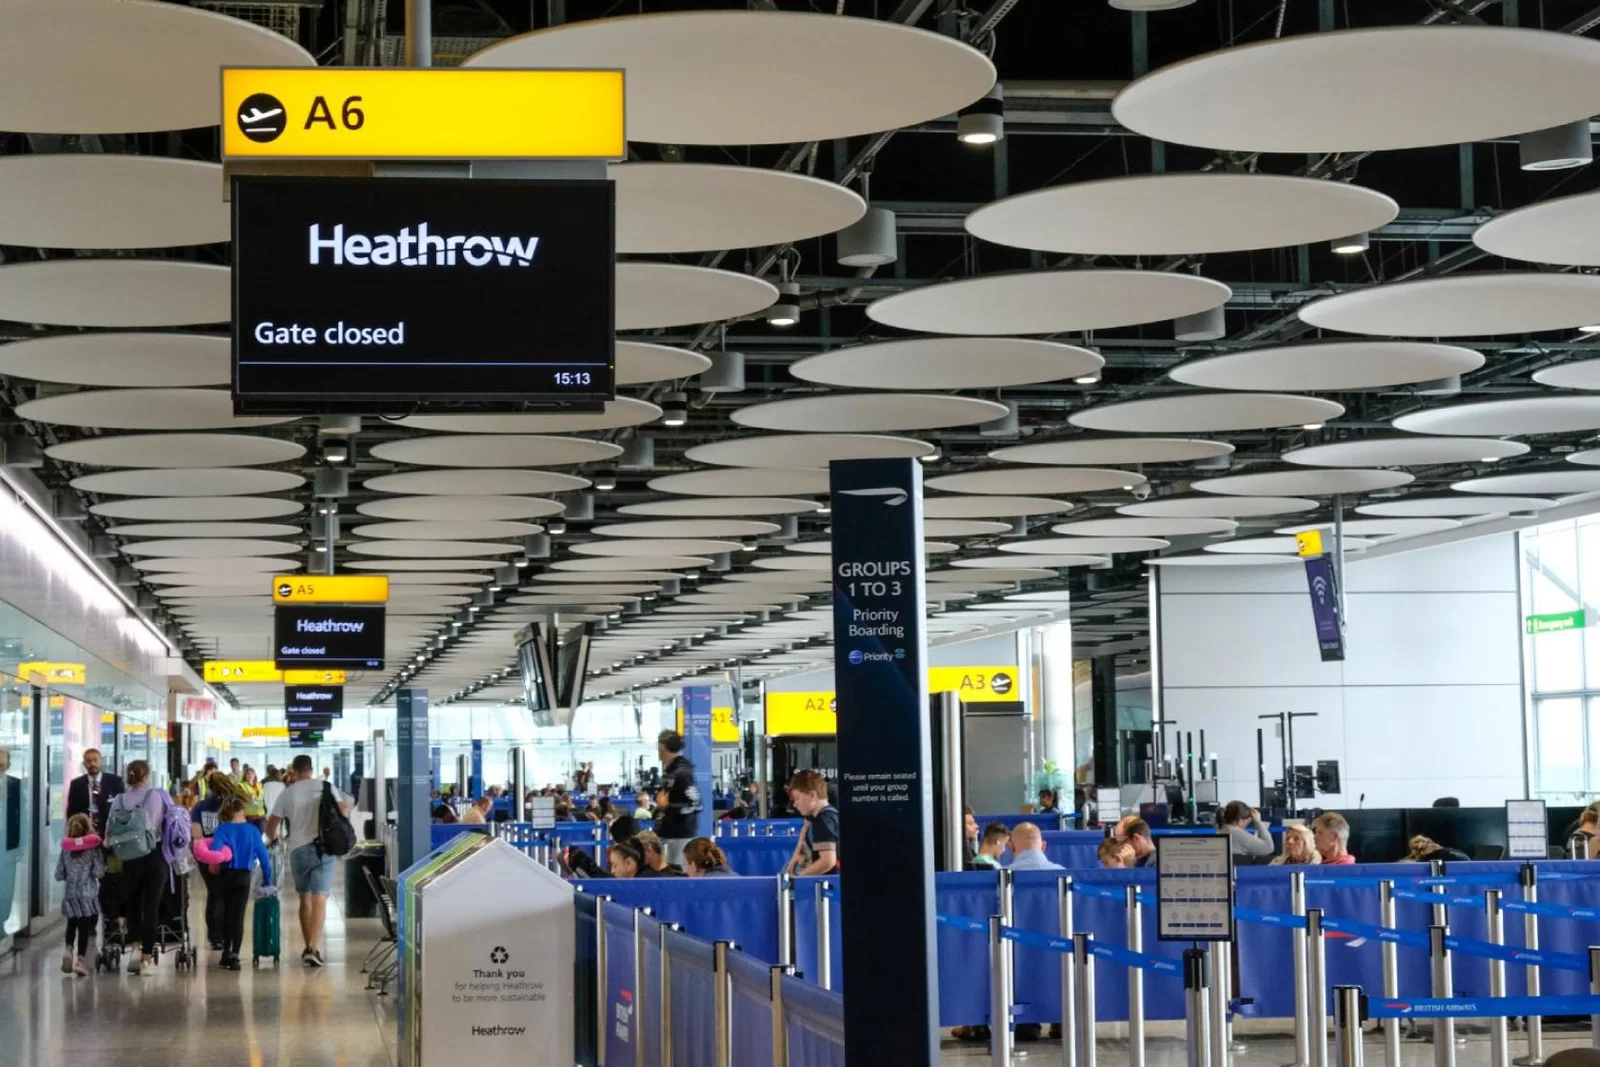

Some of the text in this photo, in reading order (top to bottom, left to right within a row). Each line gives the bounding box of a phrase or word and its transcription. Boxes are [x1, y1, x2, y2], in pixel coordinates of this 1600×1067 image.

[304, 95, 366, 131] A6
[308, 222, 539, 266] Heathrow
[254, 322, 404, 345] Gate closed
[554, 373, 591, 385] 15:13
[838, 561, 911, 577] GROUPS
[297, 584, 314, 595] A5
[848, 581, 902, 597] 1 TO 3
[853, 608, 899, 622] Priority
[297, 619, 364, 632] Heathrow
[848, 624, 904, 638] Boarding
[281, 646, 326, 655] Gate closed
[863, 651, 894, 662] Priority
[960, 675, 985, 690] A3
[296, 691, 333, 701] Heathrow
[804, 697, 826, 711] A2
[852, 783, 908, 792] until your group
[851, 794, 879, 802] number
[472, 968, 525, 980] Thank you
[454, 981, 544, 992] for helping Heathrow
[452, 995, 461, 1003] to
[463, 994, 474, 1003] be
[500, 993, 546, 1002] sustainable
[1414, 1003, 1477, 1012] BRITISH AIRWAYS
[471, 1024, 526, 1036] Heathrow
